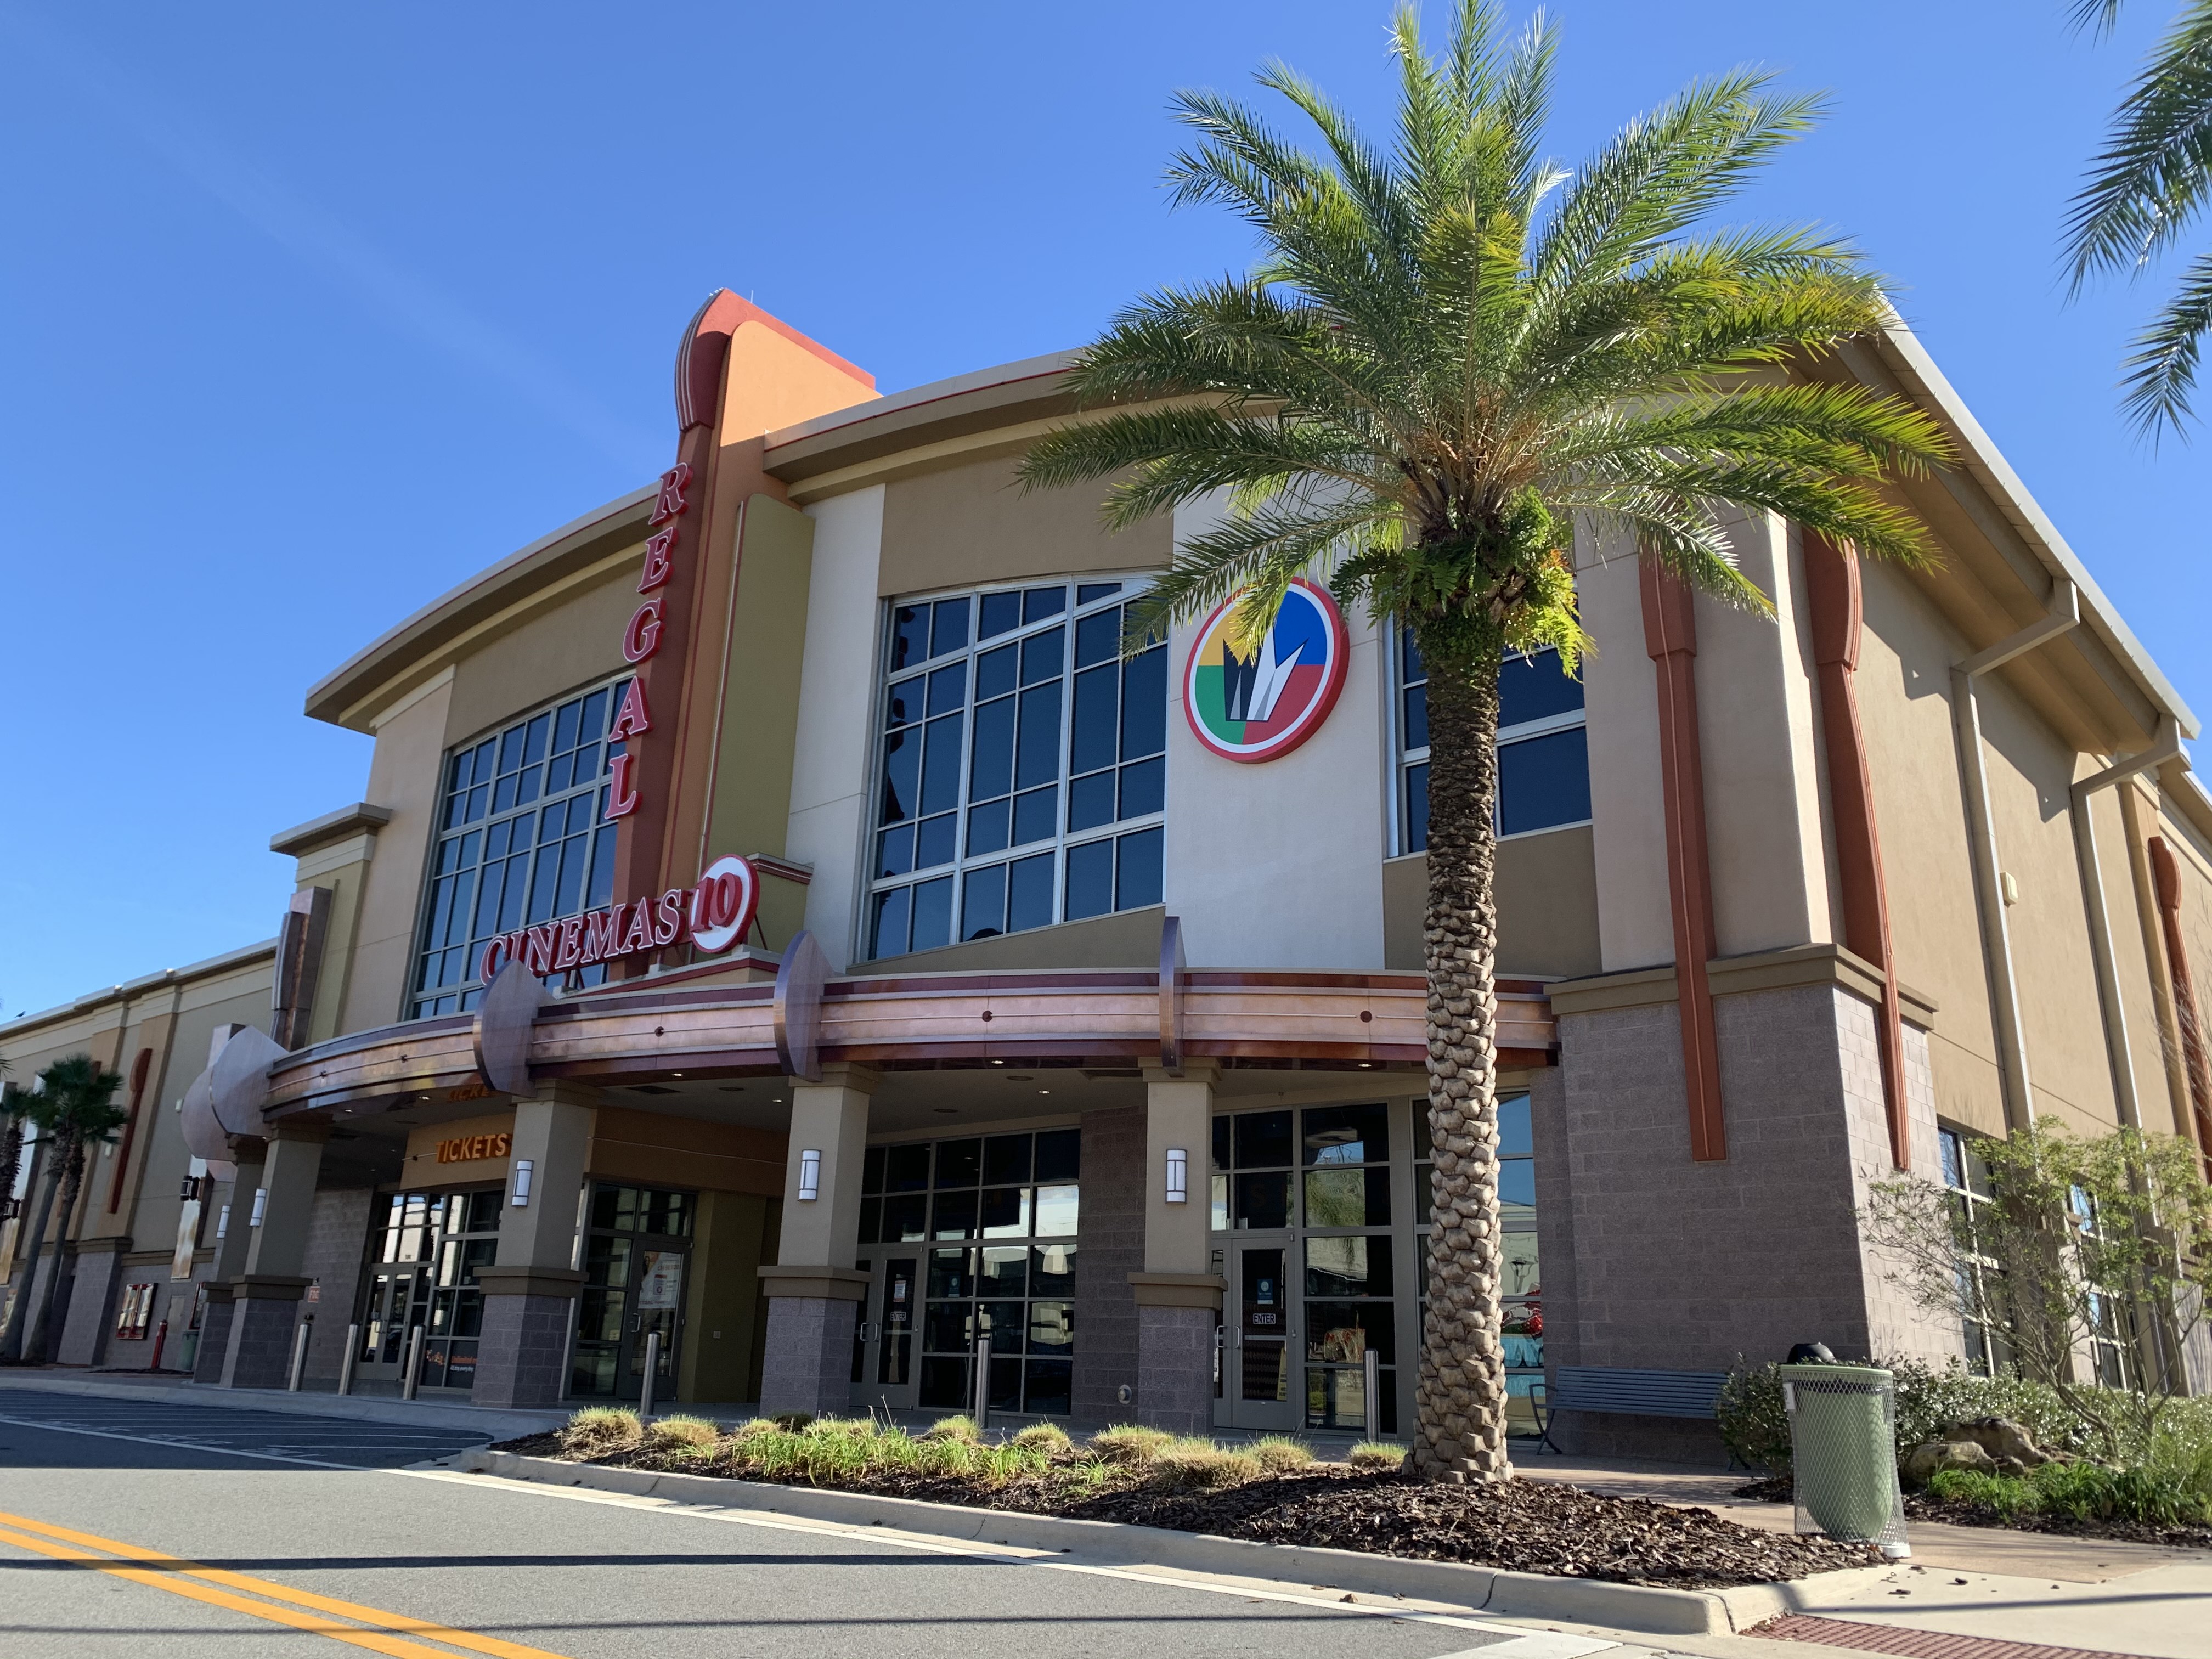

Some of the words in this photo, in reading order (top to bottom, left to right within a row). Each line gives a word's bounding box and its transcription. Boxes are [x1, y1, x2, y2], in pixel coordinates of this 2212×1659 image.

[605, 462, 693, 820] REGAL
[480, 888, 687, 986] CINEMAS
[689, 872, 743, 933] 10
[435, 1133, 511, 1164] TICKETS
[890, 1312, 906, 1321] ENTER
[1254, 1314, 1274, 1323] ENTER
